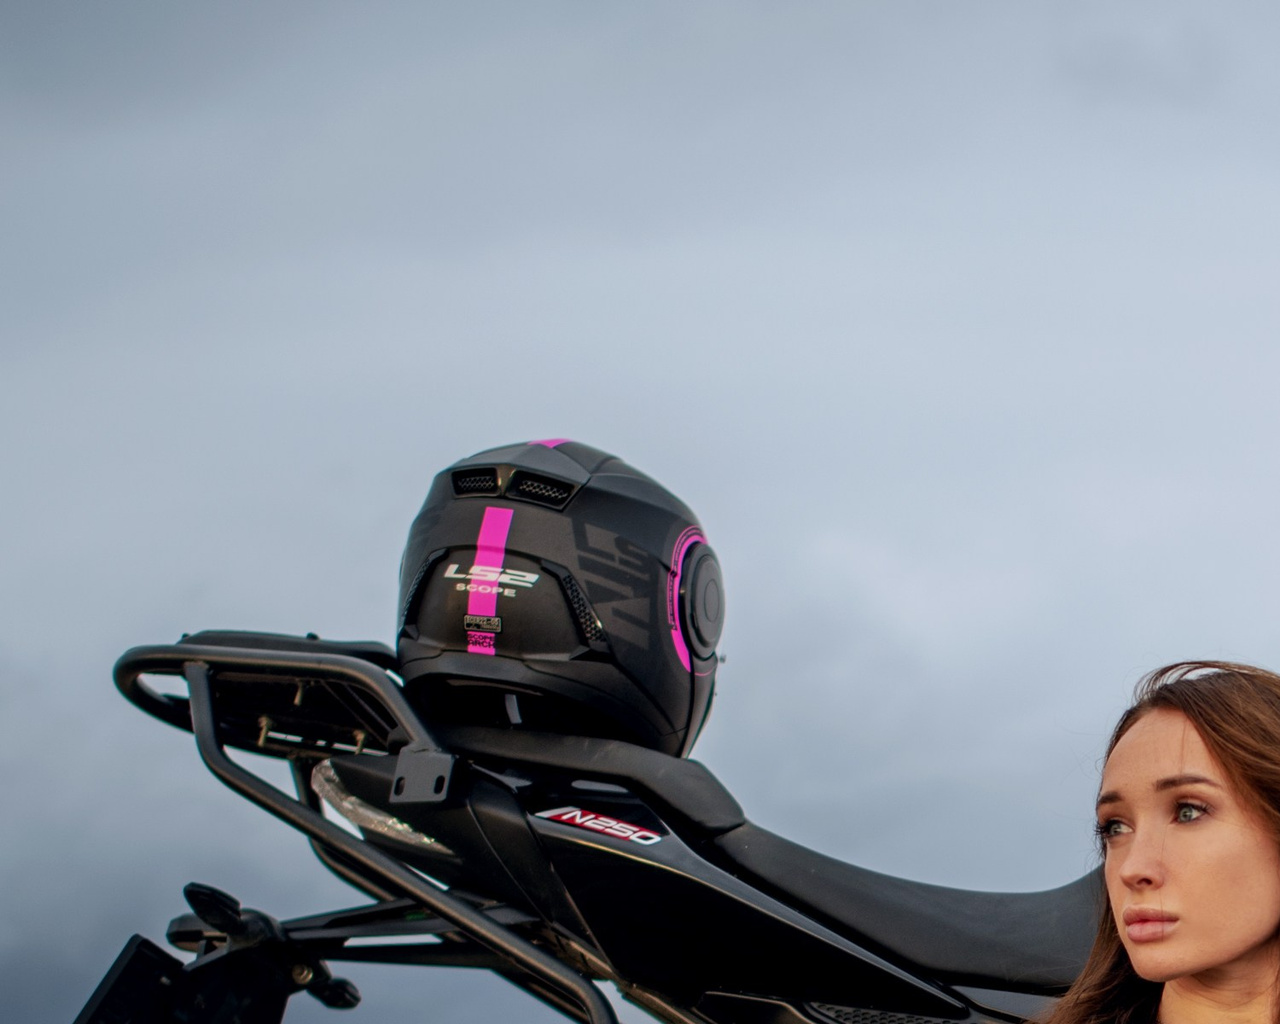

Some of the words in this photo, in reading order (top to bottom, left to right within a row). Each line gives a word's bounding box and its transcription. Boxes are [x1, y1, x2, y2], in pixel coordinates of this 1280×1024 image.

[443, 563, 540, 588] LS2
[455, 582, 517, 598] SCOPE
[467, 633, 496, 642] SCOPE
[561, 810, 662, 846] N250
